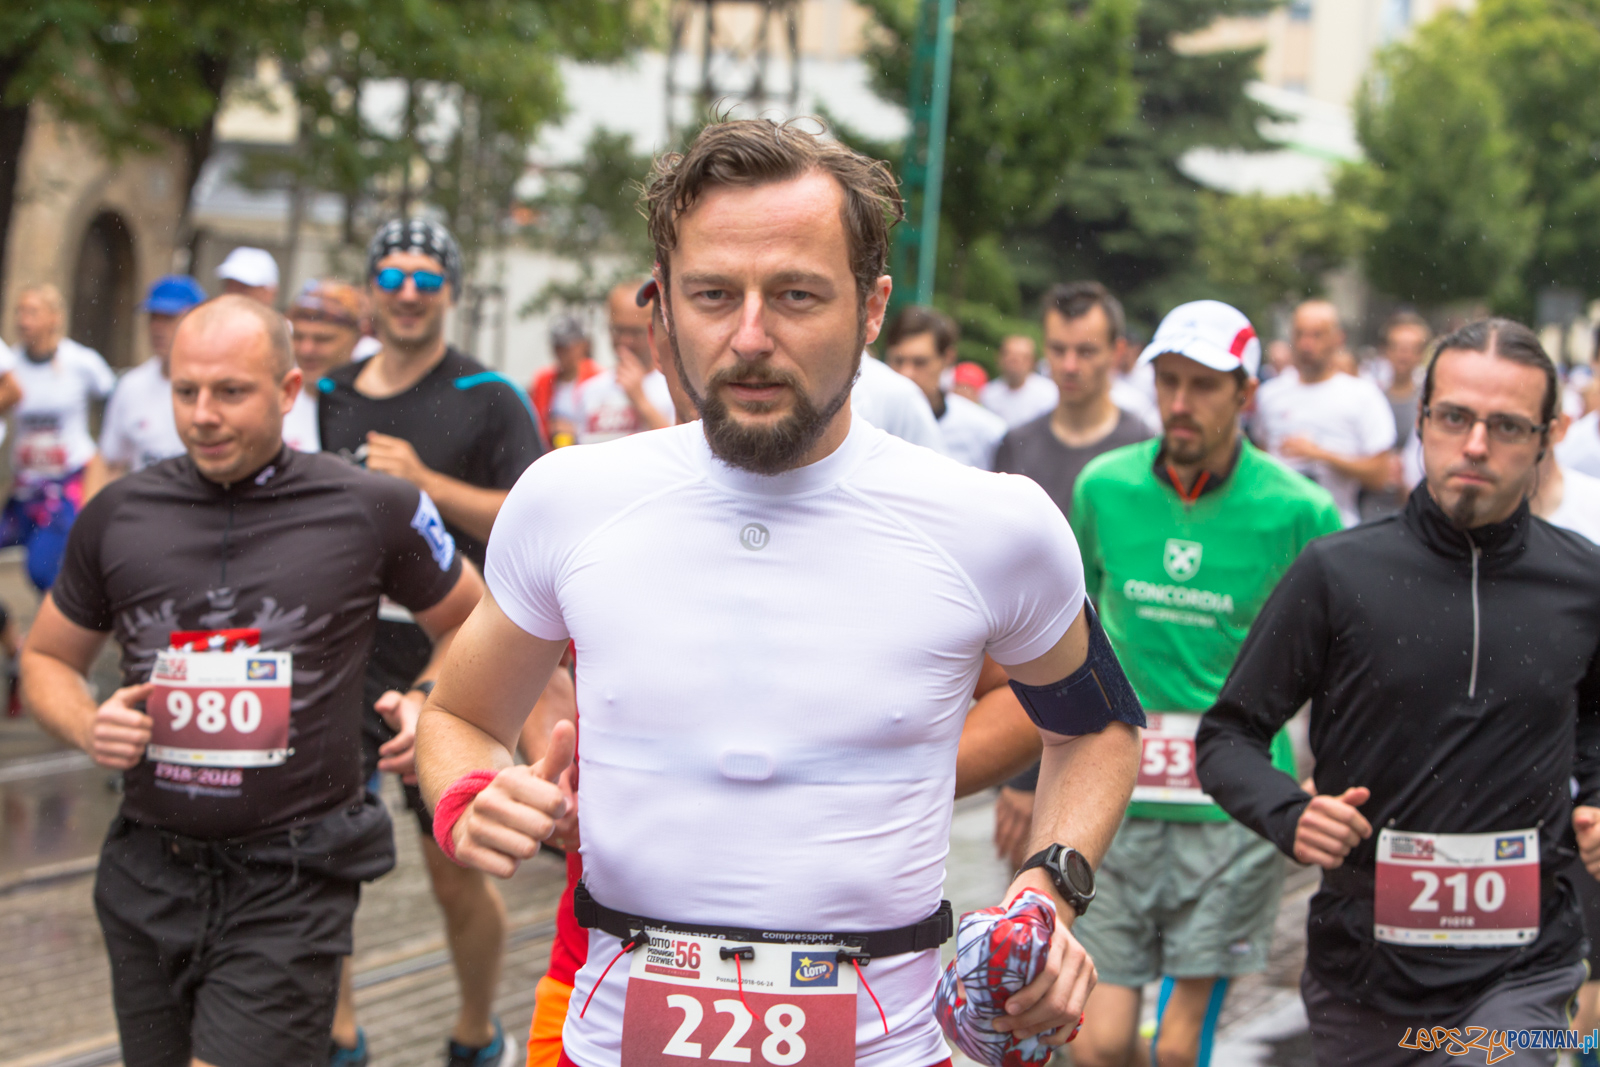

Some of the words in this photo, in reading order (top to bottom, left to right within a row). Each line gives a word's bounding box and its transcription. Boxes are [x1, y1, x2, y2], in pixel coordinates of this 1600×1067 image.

[1123, 579, 1233, 614] CONCORDIA
[167, 690, 262, 733] 980
[1409, 870, 1506, 912] 210
[762, 932, 834, 943] compressport
[803, 964, 827, 978] LOTTO
[662, 994, 806, 1067] 228
